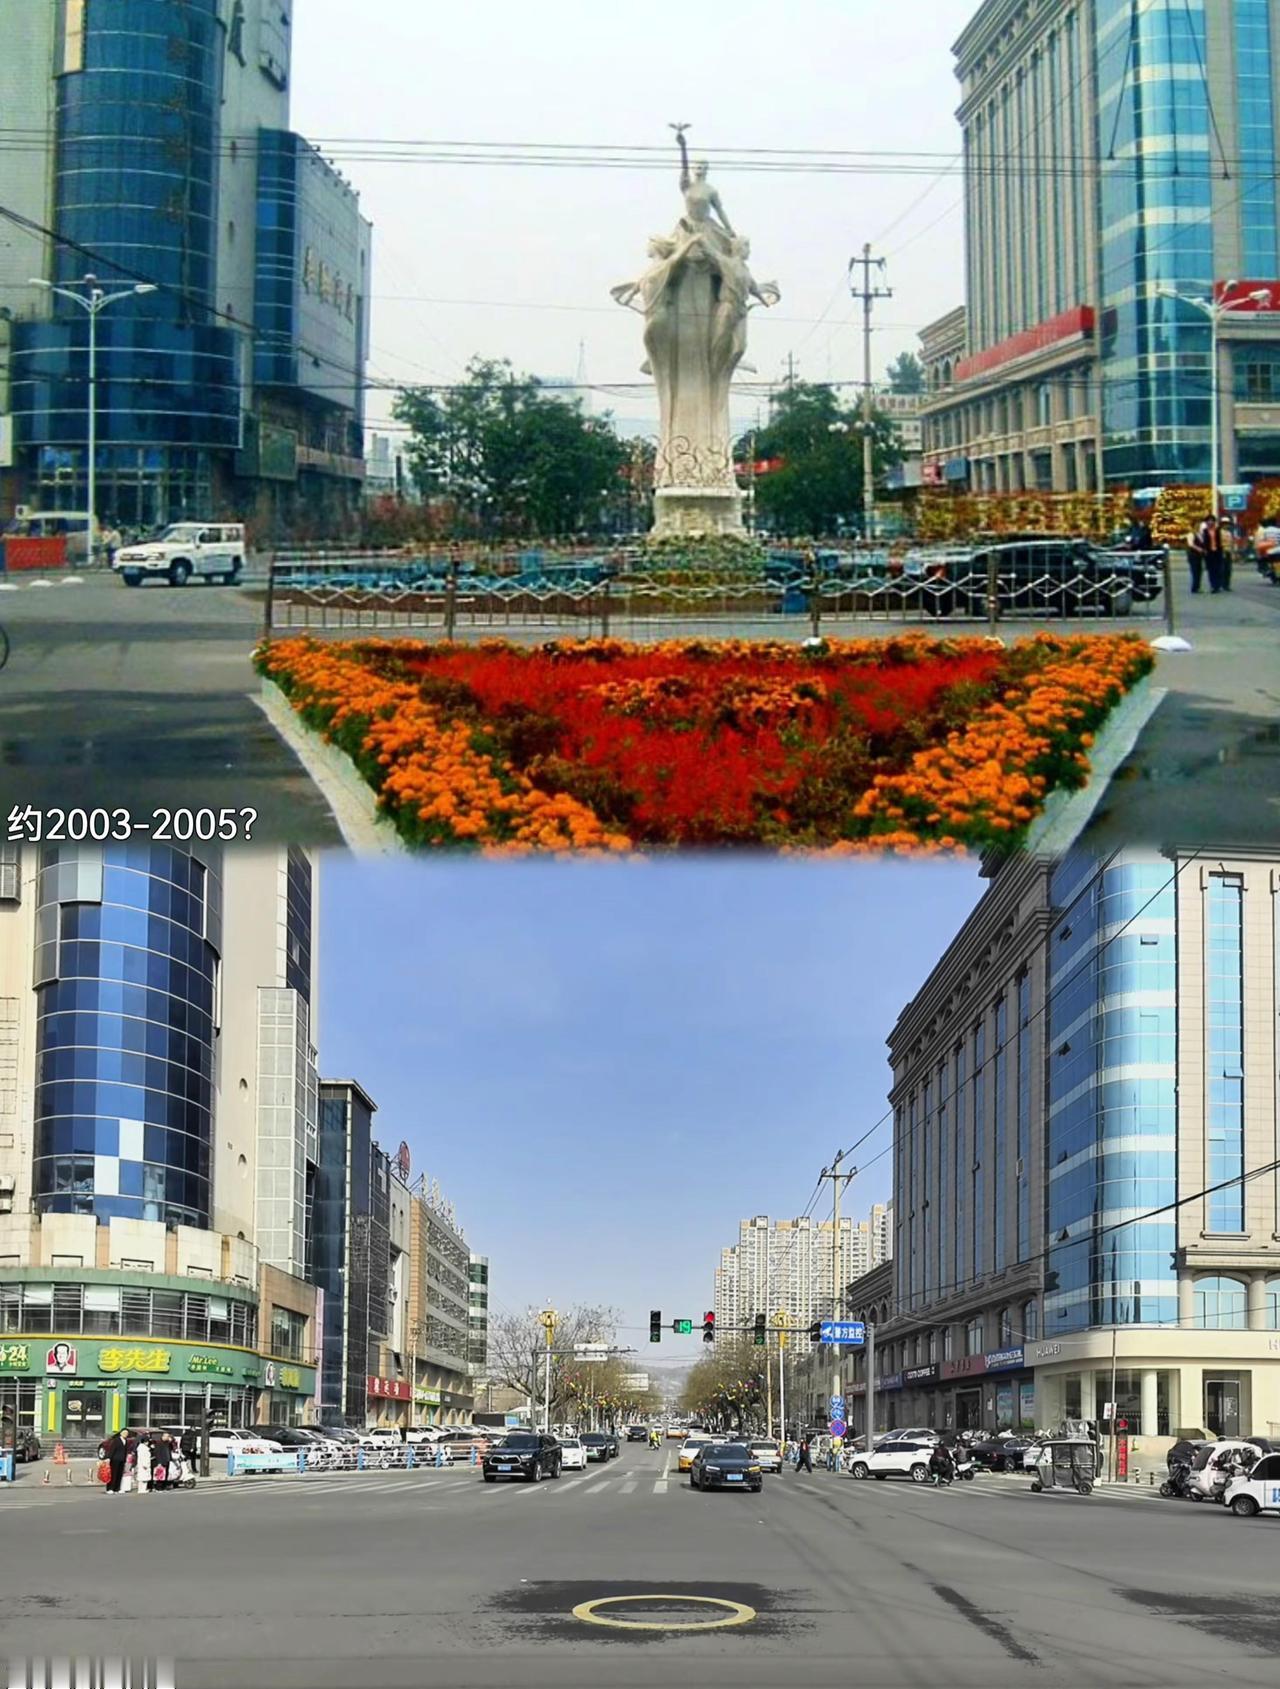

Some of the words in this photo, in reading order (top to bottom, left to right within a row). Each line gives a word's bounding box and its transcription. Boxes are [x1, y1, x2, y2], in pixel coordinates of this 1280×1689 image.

[99, 1347, 170, 1372] 李先生
[1035, 1343, 1061, 1358] HUAWEI
